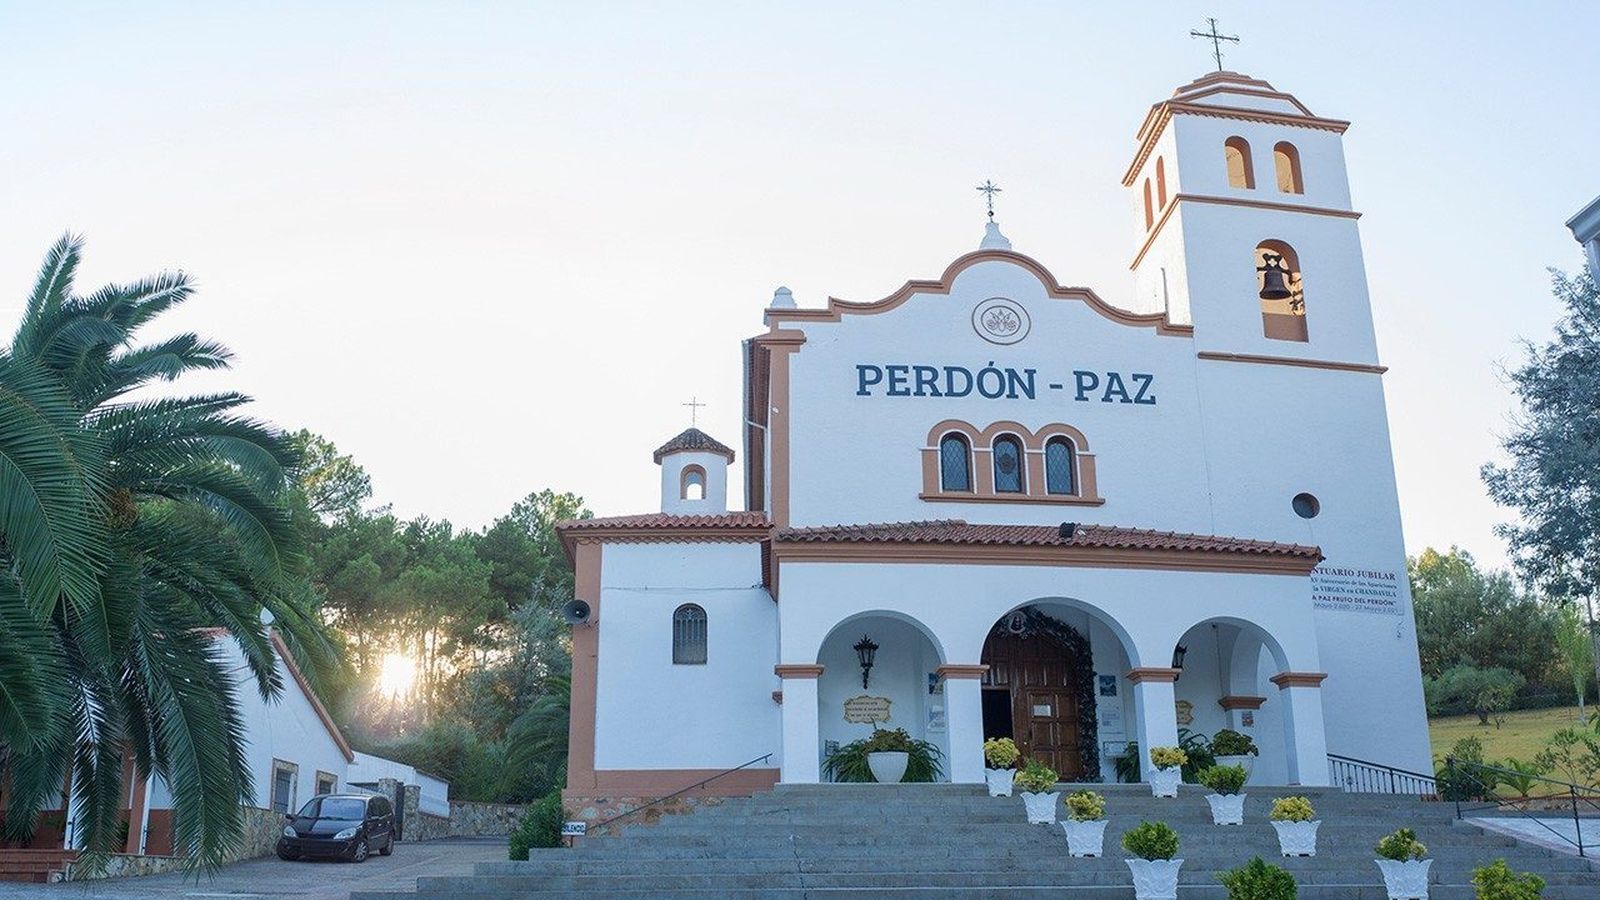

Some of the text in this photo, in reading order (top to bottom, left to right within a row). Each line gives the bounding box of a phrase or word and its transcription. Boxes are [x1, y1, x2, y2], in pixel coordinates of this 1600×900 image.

[856, 361, 1037, 400] PERDÓN
[1073, 370, 1156, 405] PAZ
[1357, 570, 1396, 581] JUBILAR
